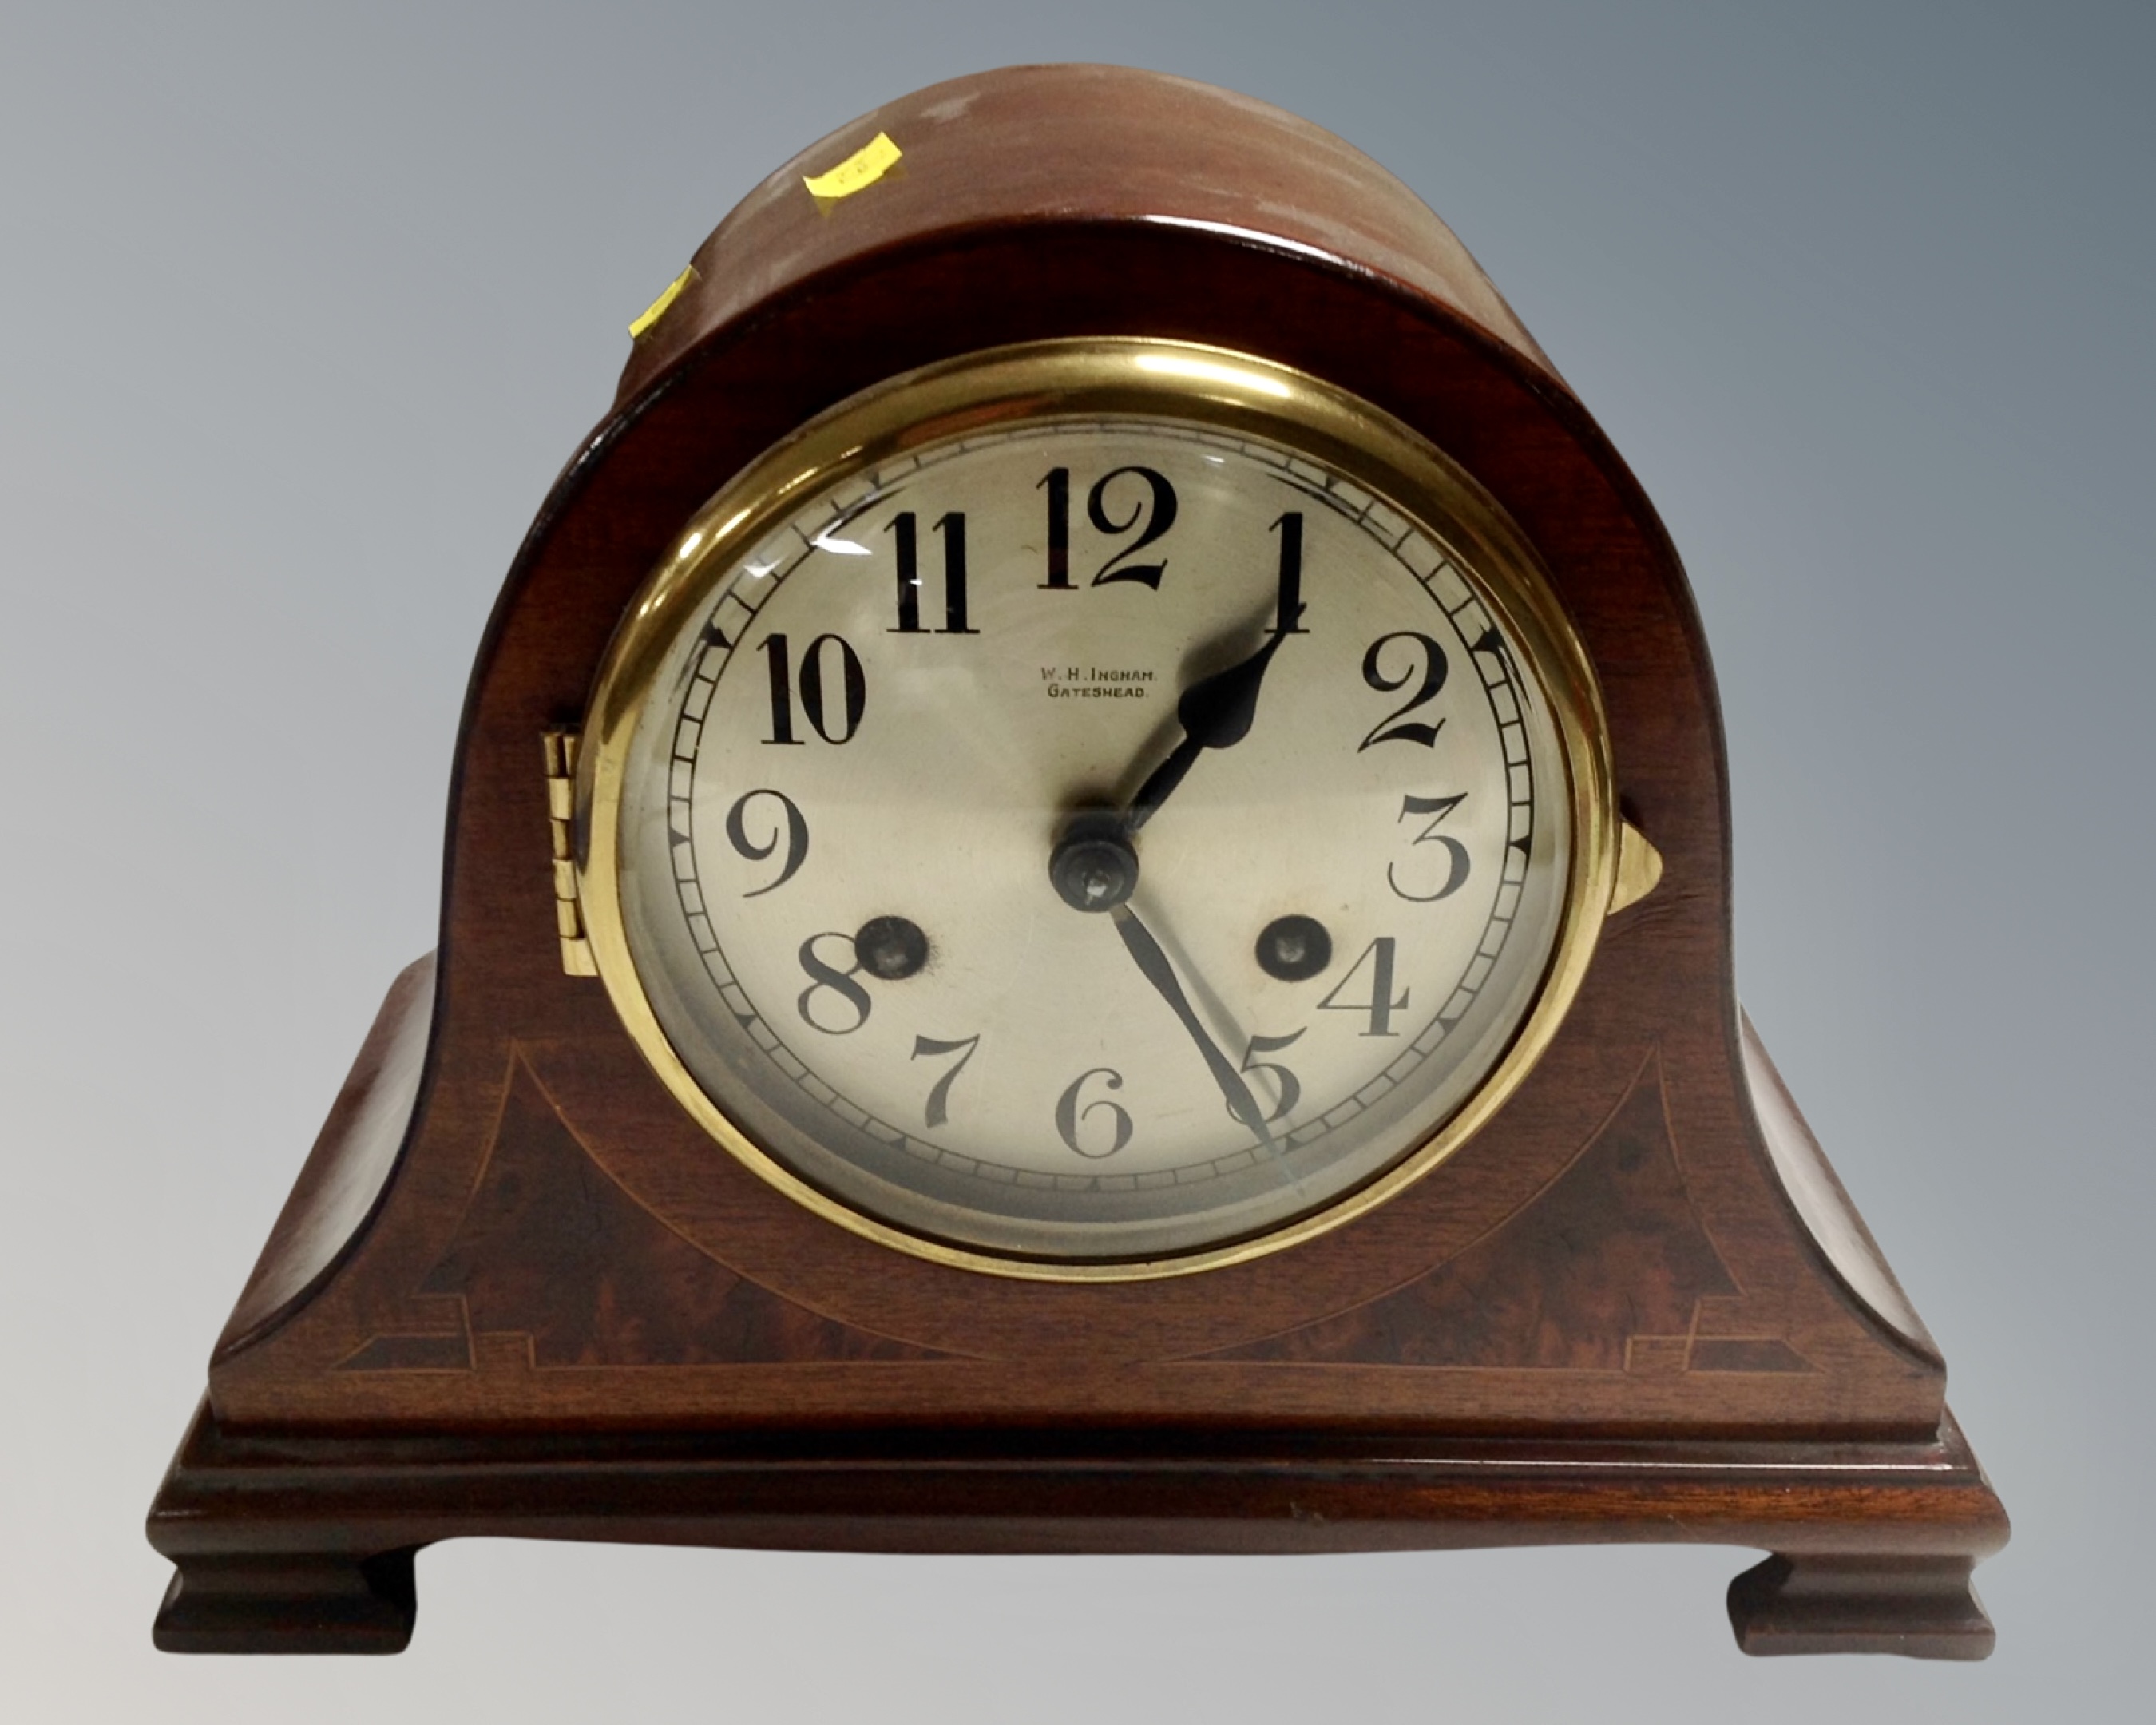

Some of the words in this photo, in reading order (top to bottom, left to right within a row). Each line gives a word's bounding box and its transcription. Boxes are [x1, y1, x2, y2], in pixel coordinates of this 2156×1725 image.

[884, 512, 981, 634] 11
[1035, 466, 1177, 591] 12
[1265, 512, 1311, 633] 1
[755, 633, 867, 744] 10
[1357, 632, 1448, 752] 2
[725, 789, 810, 898] 9
[1387, 793, 1471, 902] 3
[798, 931, 872, 1034] 8
[1316, 936, 1410, 1037] 4
[910, 1033, 981, 1128] 7
[1056, 1068, 1134, 1158] 6
[1226, 1025, 1308, 1124] 5
